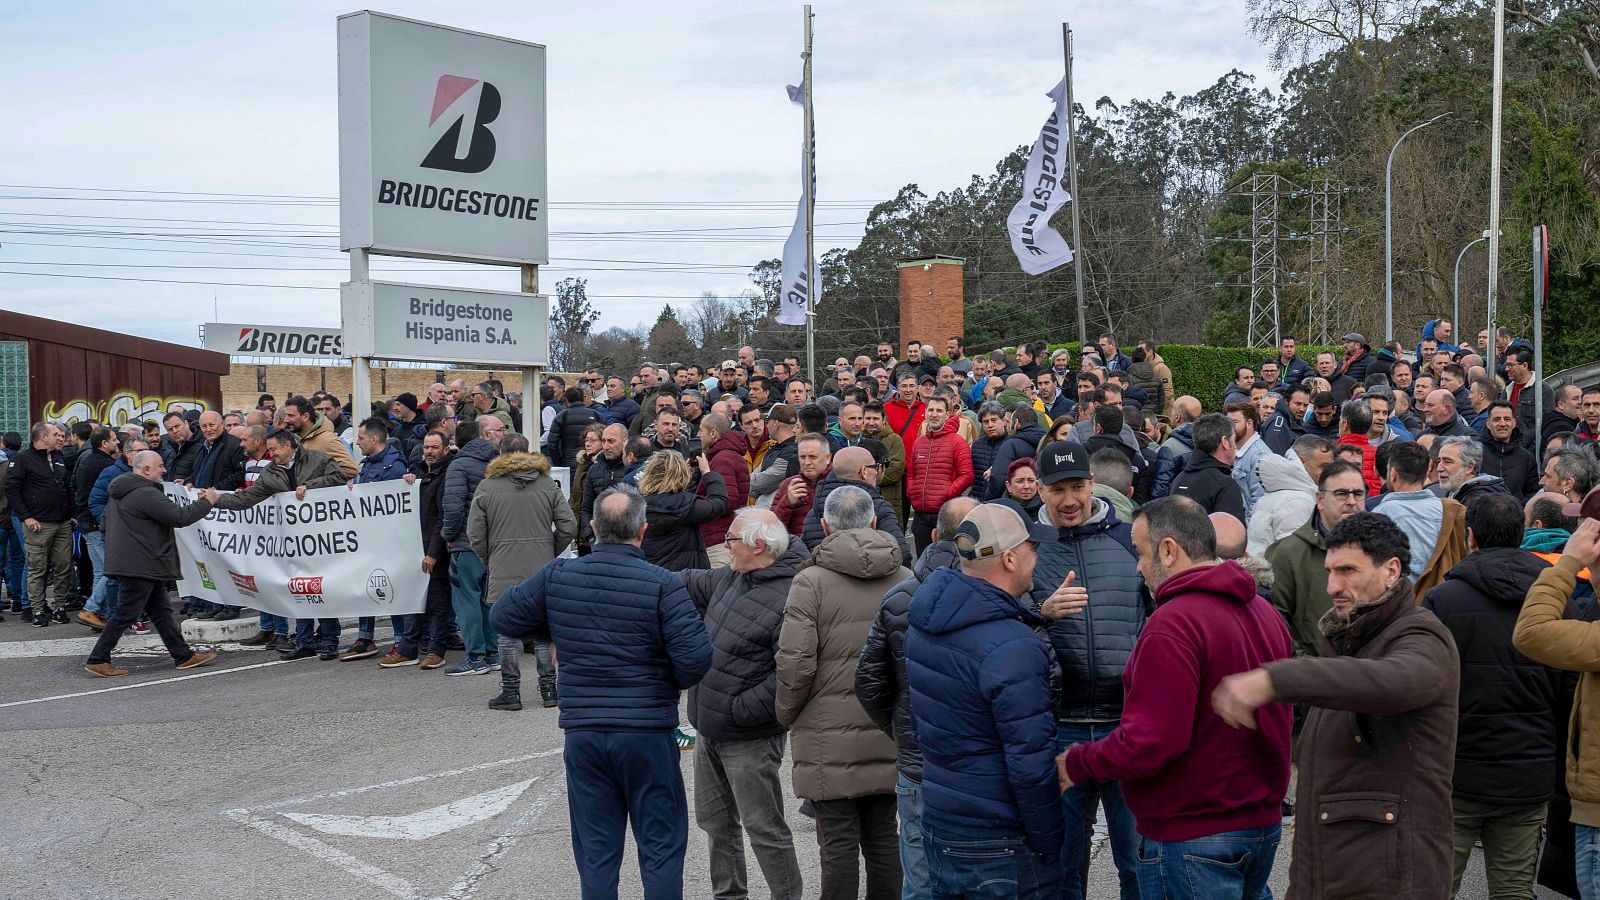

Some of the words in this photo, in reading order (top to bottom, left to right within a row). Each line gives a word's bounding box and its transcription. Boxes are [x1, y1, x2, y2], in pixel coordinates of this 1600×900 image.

[378, 179, 540, 221] BRIDGESTONE
[409, 297, 513, 322] Bridgestone
[237, 327, 342, 356] BRIDGES
[405, 321, 481, 345] Hispania
[485, 326, 517, 345] S.A.
[285, 498, 357, 525] SOBRA
[360, 491, 412, 518] NADIE
[255, 530, 359, 558] SOLUCIONES
[288, 578, 312, 593] UGT
[369, 575, 388, 588] SITB
[306, 595, 325, 604] FICA
